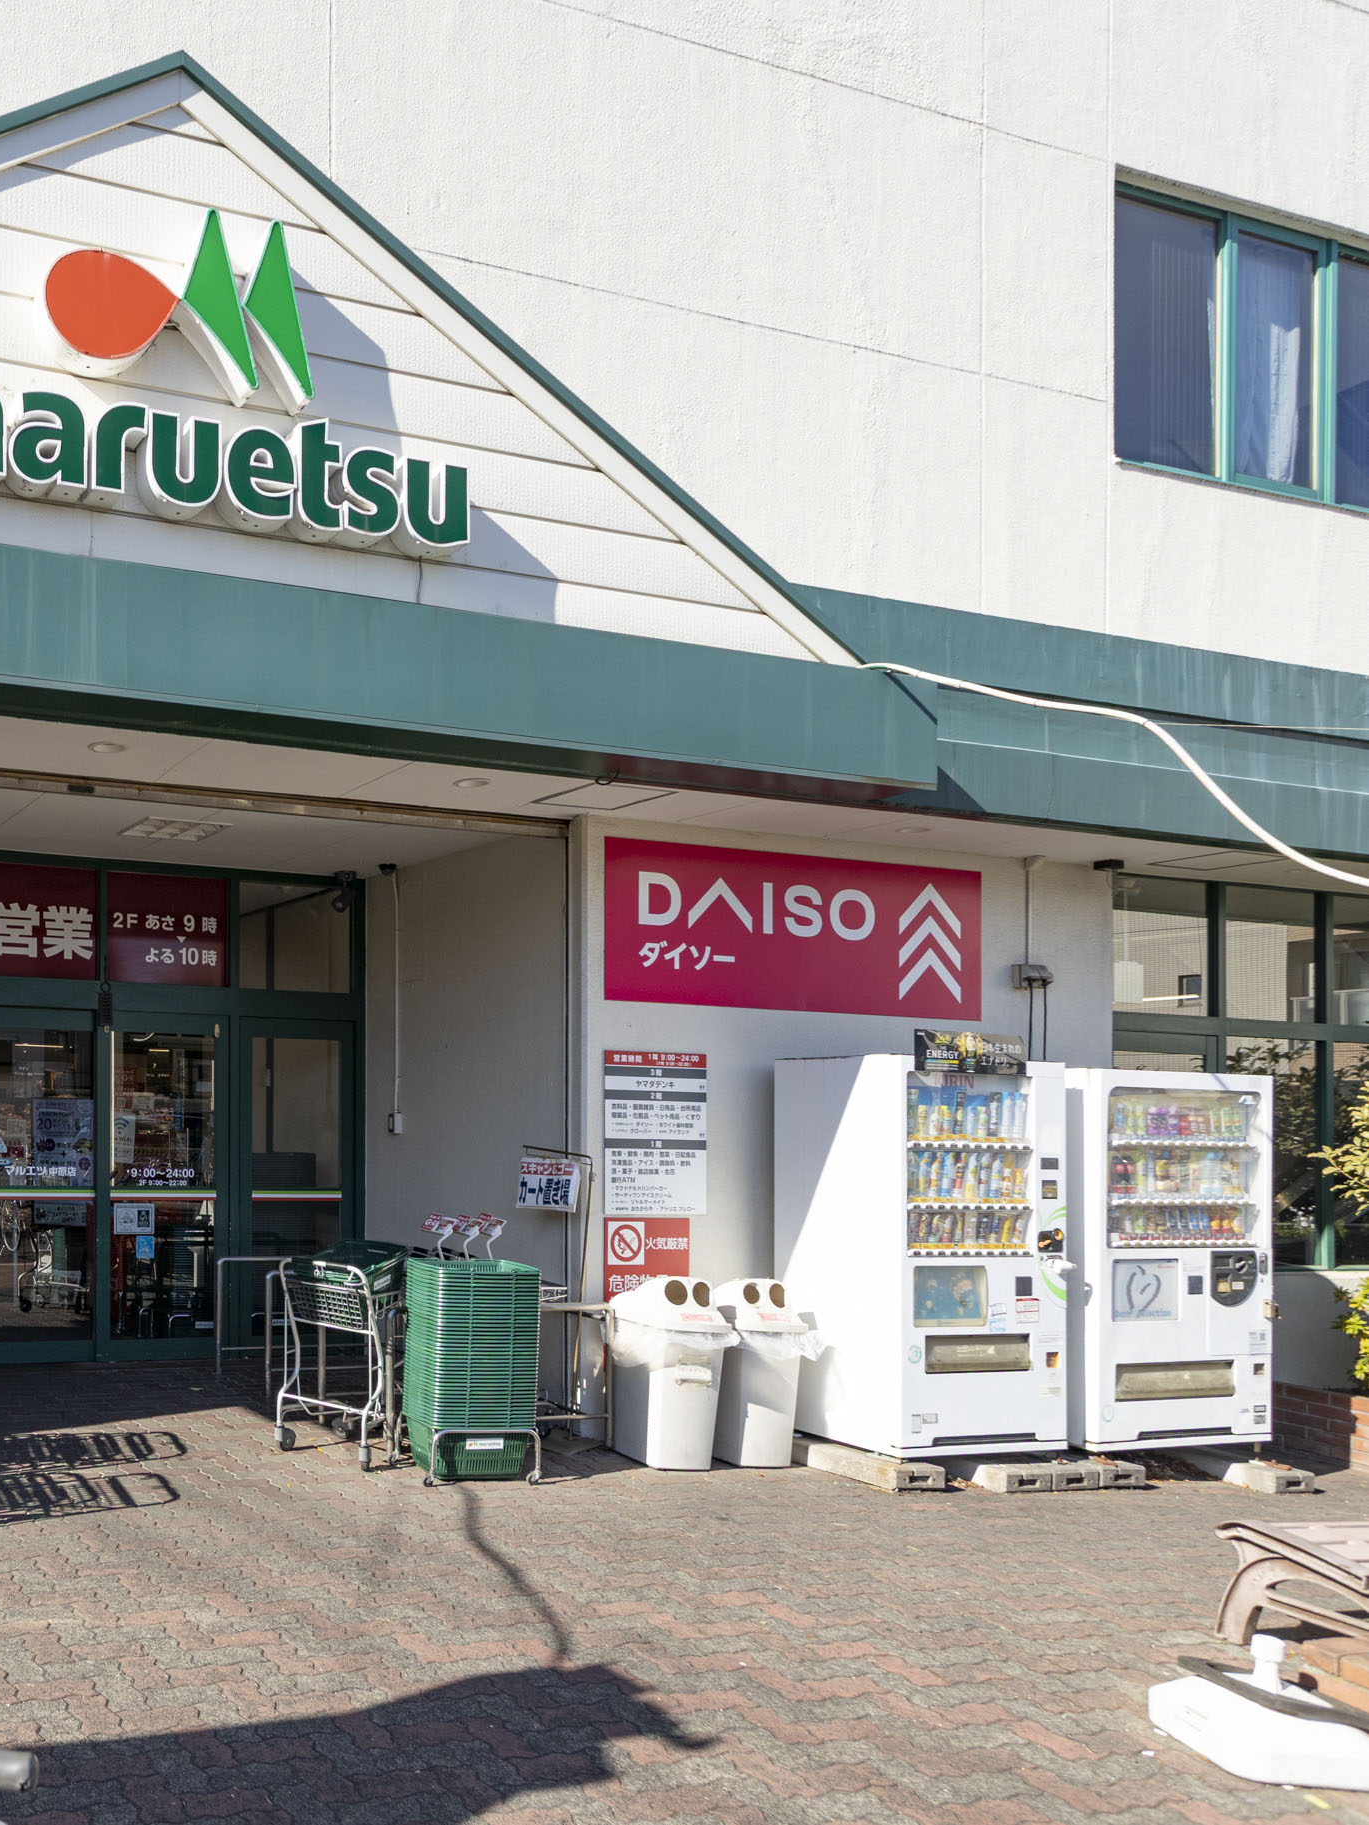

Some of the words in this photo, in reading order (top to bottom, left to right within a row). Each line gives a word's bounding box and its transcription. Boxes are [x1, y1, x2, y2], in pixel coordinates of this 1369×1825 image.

[638, 870, 876, 941] DAISO
[112, 911, 139, 929] 2F
[638, 940, 736, 971] ダイソー
[981, 1041, 1022, 1055] 日本生まれの
[613, 1054, 642, 1063] 営業時間
[926, 1049, 960, 1060] ENERGY
[649, 1068, 663, 1077] 3階
[636, 1080, 675, 1089] ヤマダデンキ
[650, 1092, 663, 1100] 2階
[650, 1140, 662, 1149] 1階
[4, 1165, 47, 1177] マルエツ
[48, 1166, 77, 1177] 中原店
[611, 1176, 636, 1184] 銀行ATM
[518, 1176, 572, 1206] カート置き場
[645, 1236, 689, 1251] 火気厳禁
